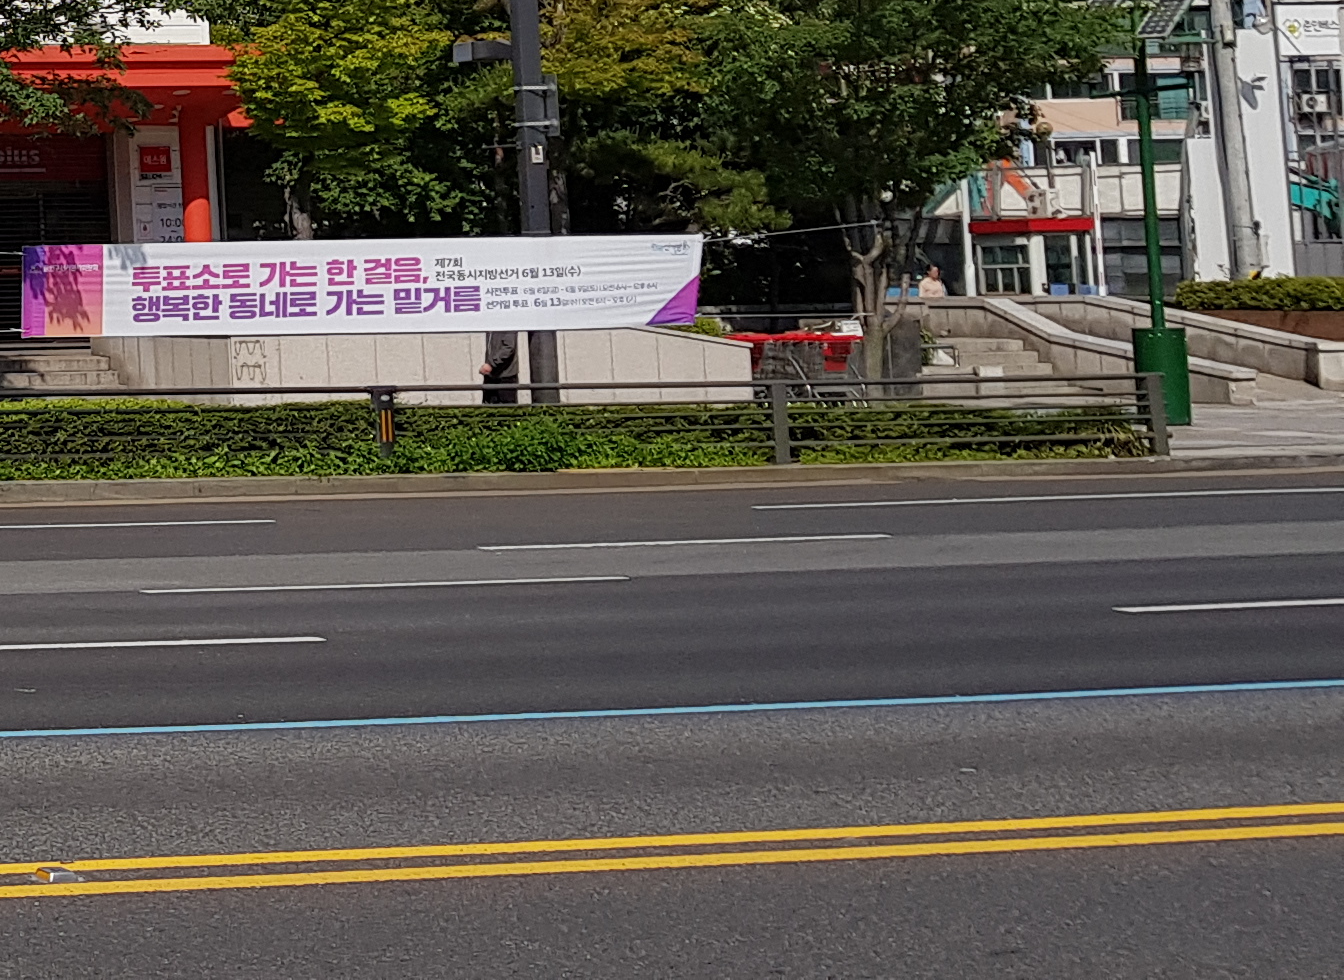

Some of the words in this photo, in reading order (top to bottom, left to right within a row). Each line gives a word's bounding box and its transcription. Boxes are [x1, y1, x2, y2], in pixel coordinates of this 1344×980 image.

[160, 217, 182, 228] 10:0
[160, 235, 183, 243] 24:0
[434, 256, 463, 268] 제7회
[131, 263, 251, 292] 투표소로
[259, 261, 318, 288] 가는
[326, 259, 357, 285] 한
[363, 256, 429, 285] 걸음,
[435, 267, 520, 282] 전국동시지방선거
[522, 267, 539, 278] 6월
[542, 266, 582, 279] 13일(수)
[131, 293, 223, 322] 행복한
[228, 291, 318, 319] 동네로
[326, 290, 384, 316] 가는
[393, 286, 482, 315] 밑거름
